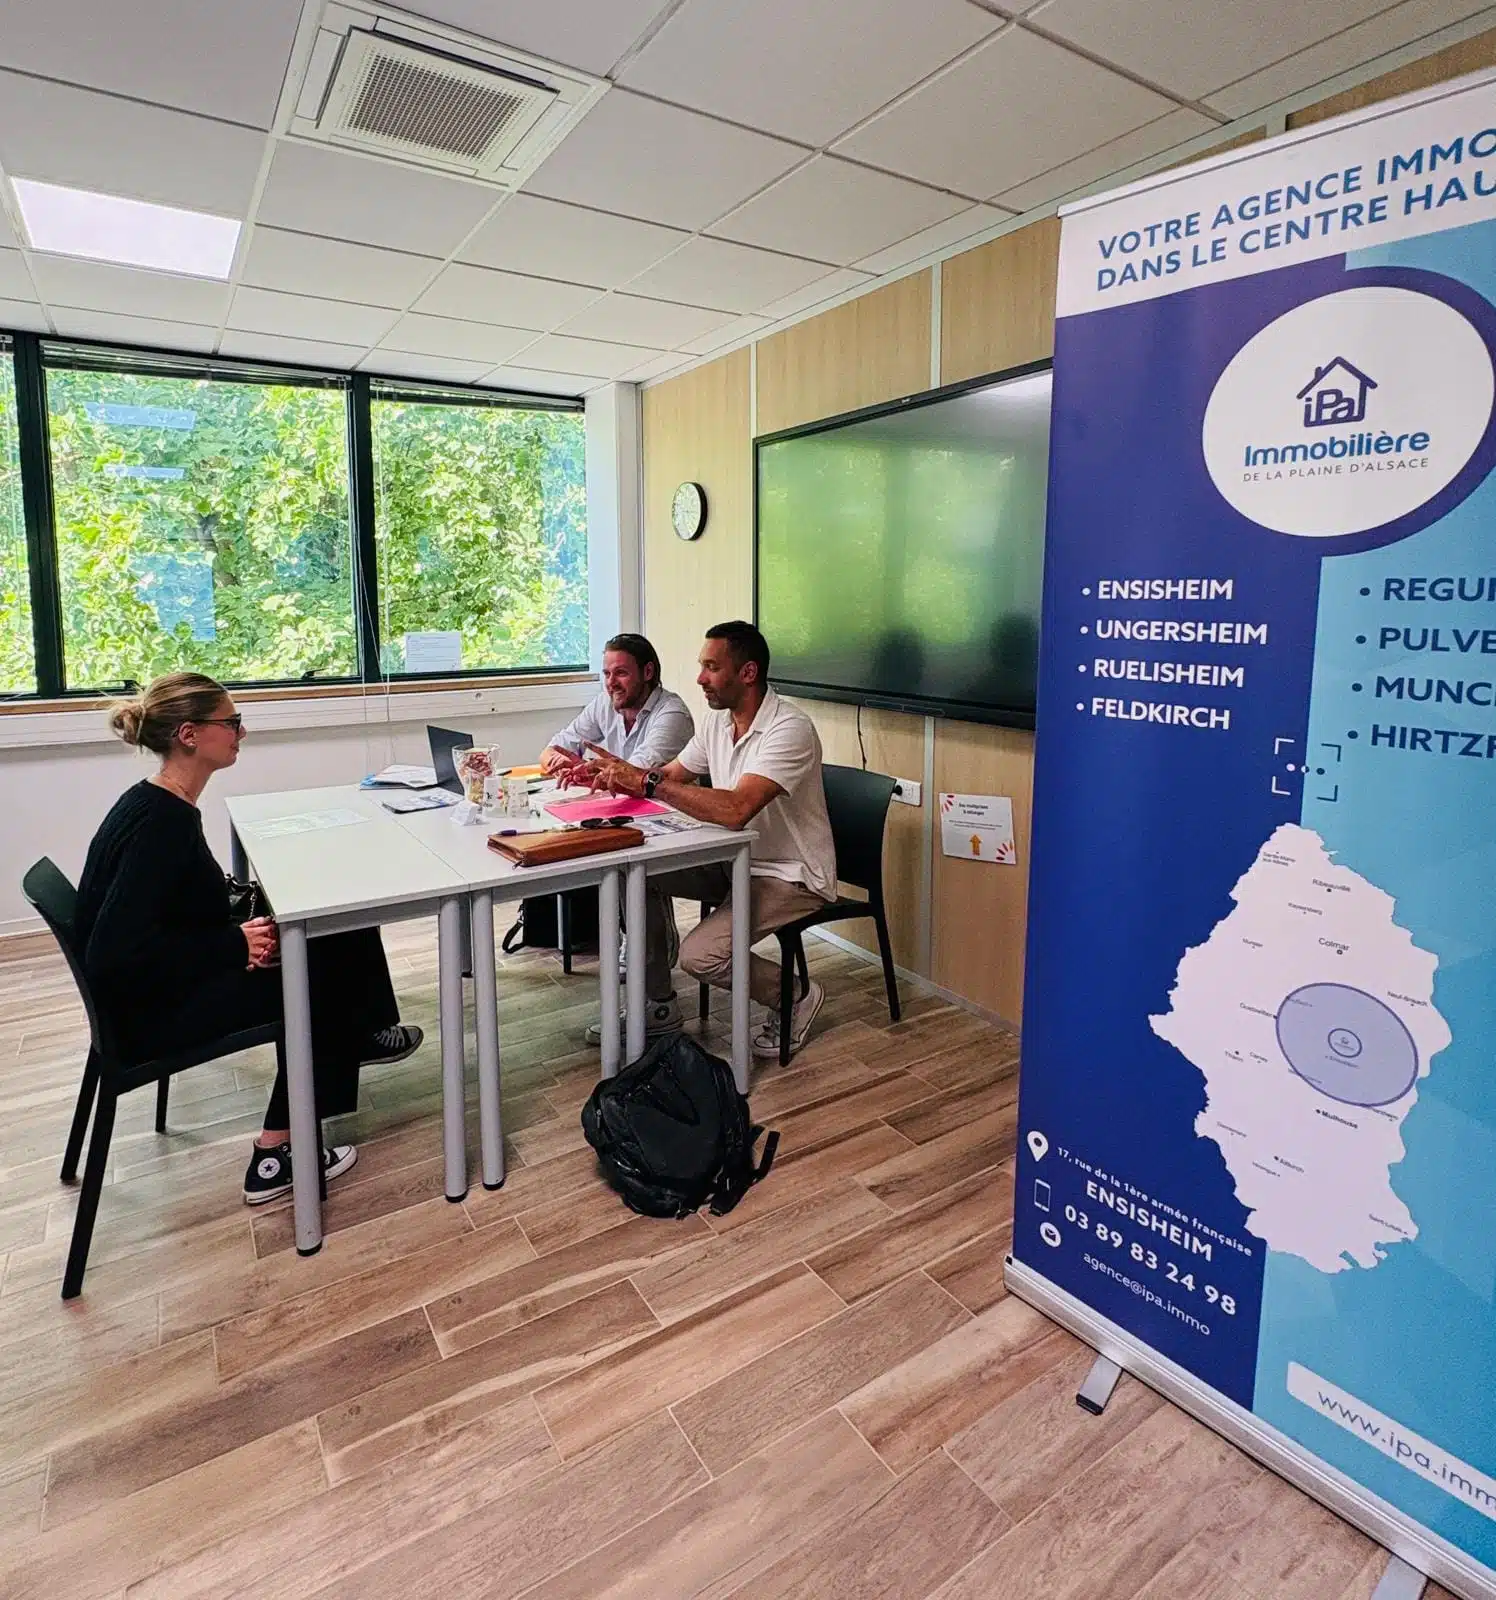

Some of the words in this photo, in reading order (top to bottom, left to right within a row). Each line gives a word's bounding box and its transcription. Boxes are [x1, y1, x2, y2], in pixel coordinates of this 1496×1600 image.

[1098, 211, 1201, 260] VOTRE
[1211, 165, 1363, 230] AGENCE
[1376, 128, 1496, 186] IMMO
[1097, 249, 1181, 292] DANS
[1191, 237, 1228, 268] LE
[1238, 194, 1389, 254] CENTRE
[1403, 170, 1496, 216] HAU
[1244, 430, 1430, 467] Immobilière
[1242, 472, 1261, 482] DE
[1265, 470, 1283, 481] LA
[1288, 464, 1342, 478] PLAINE
[1349, 457, 1429, 473] D'ALSACE
[1097, 578, 1234, 601] ENSISHEIM
[1095, 619, 1269, 645] UNGERSHEIM
[1379, 626, 1496, 655] PULVE
[1093, 658, 1245, 688] RUELISHEIM
[1374, 675, 1496, 707] MUNC
[1090, 697, 1231, 730] FELDKIRCH
[1318, 937, 1350, 951] Colmar
[1057, 1146, 1073, 1163] 17,
[1074, 1158, 1092, 1173] rue
[1094, 1168, 1108, 1181] de
[1110, 1175, 1121, 1188] la
[1151, 1198, 1189, 1224] armée
[1192, 1216, 1253, 1257] française
[1086, 1179, 1213, 1263] ENSISHEIM
[1064, 1204, 1089, 1230] 03
[1095, 1223, 1123, 1248] 89
[1130, 1242, 1158, 1270] 83
[1165, 1262, 1196, 1292] 24
[1204, 1284, 1236, 1316] 98
[1083, 1252, 1211, 1336] agence@ipa.immo
